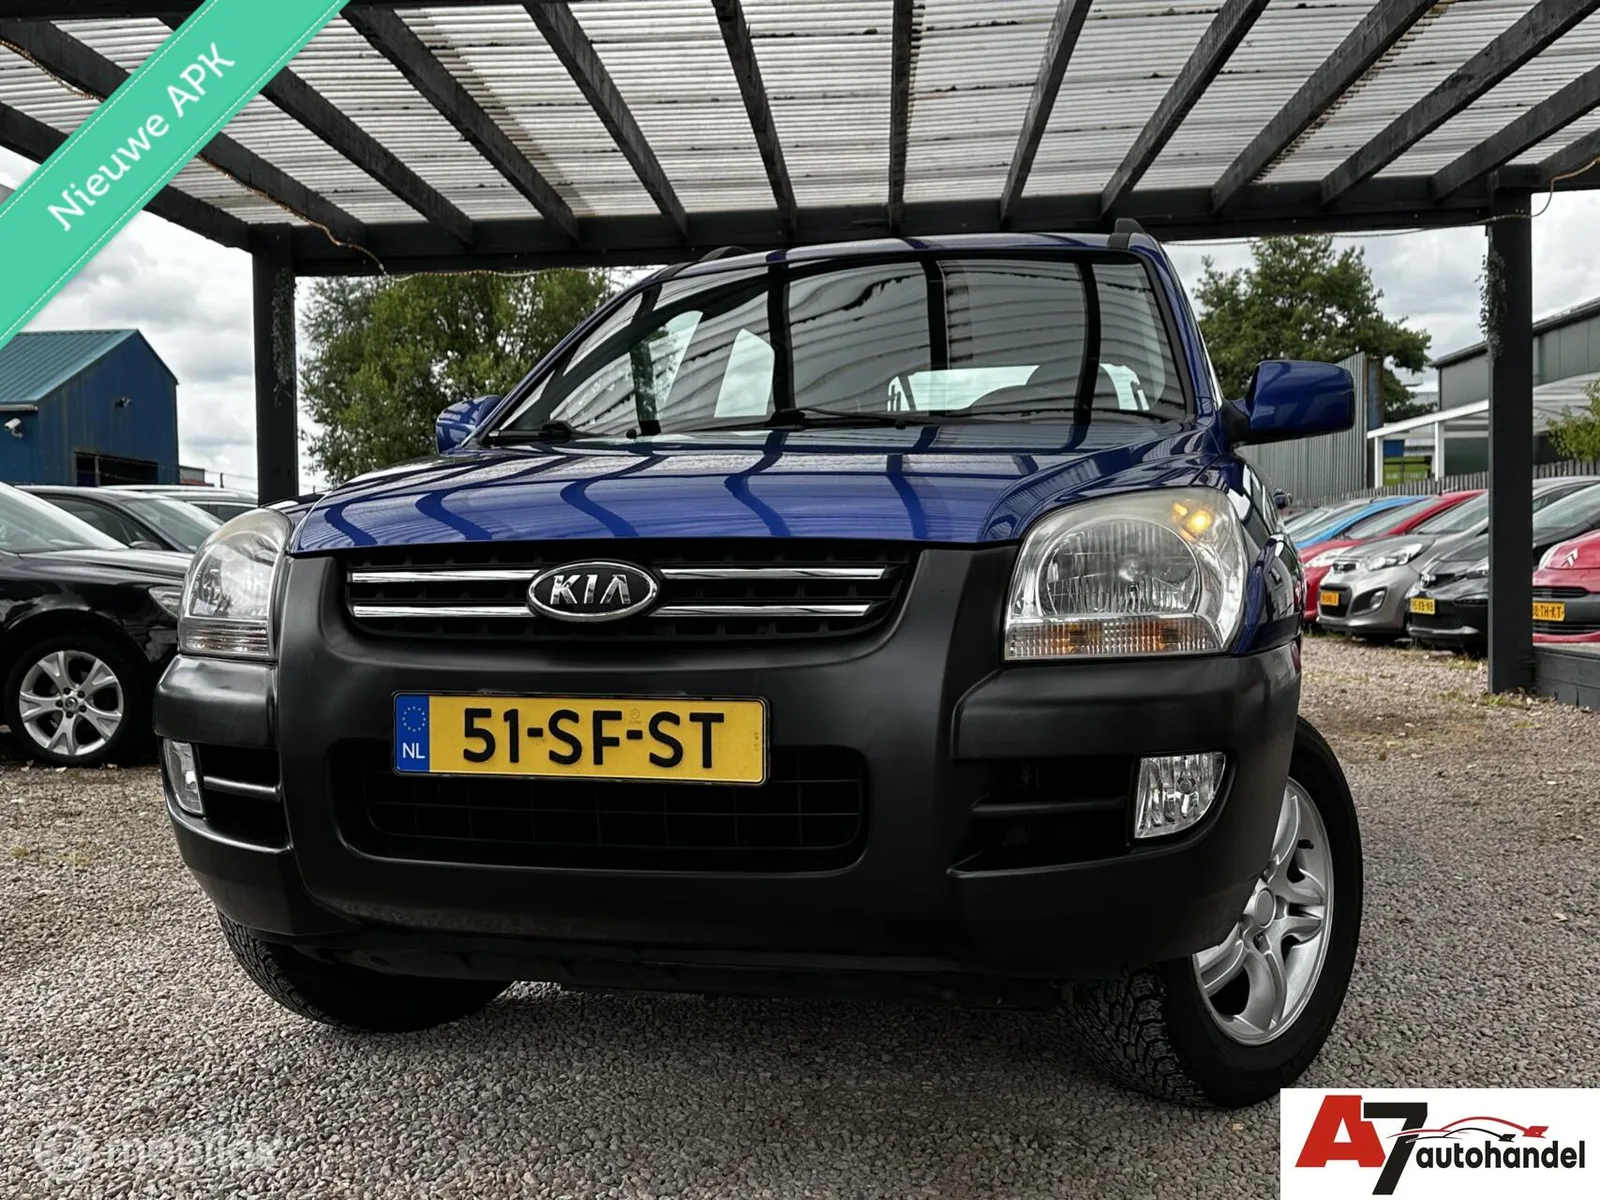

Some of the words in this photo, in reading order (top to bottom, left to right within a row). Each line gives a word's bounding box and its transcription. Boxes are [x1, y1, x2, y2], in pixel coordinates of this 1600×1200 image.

[549, 573, 632, 605] KIA
[1534, 604, 1562, 619] 8-TH-KT
[462, 706, 725, 769] 51-SF-ST
[402, 742, 426, 760] NL
